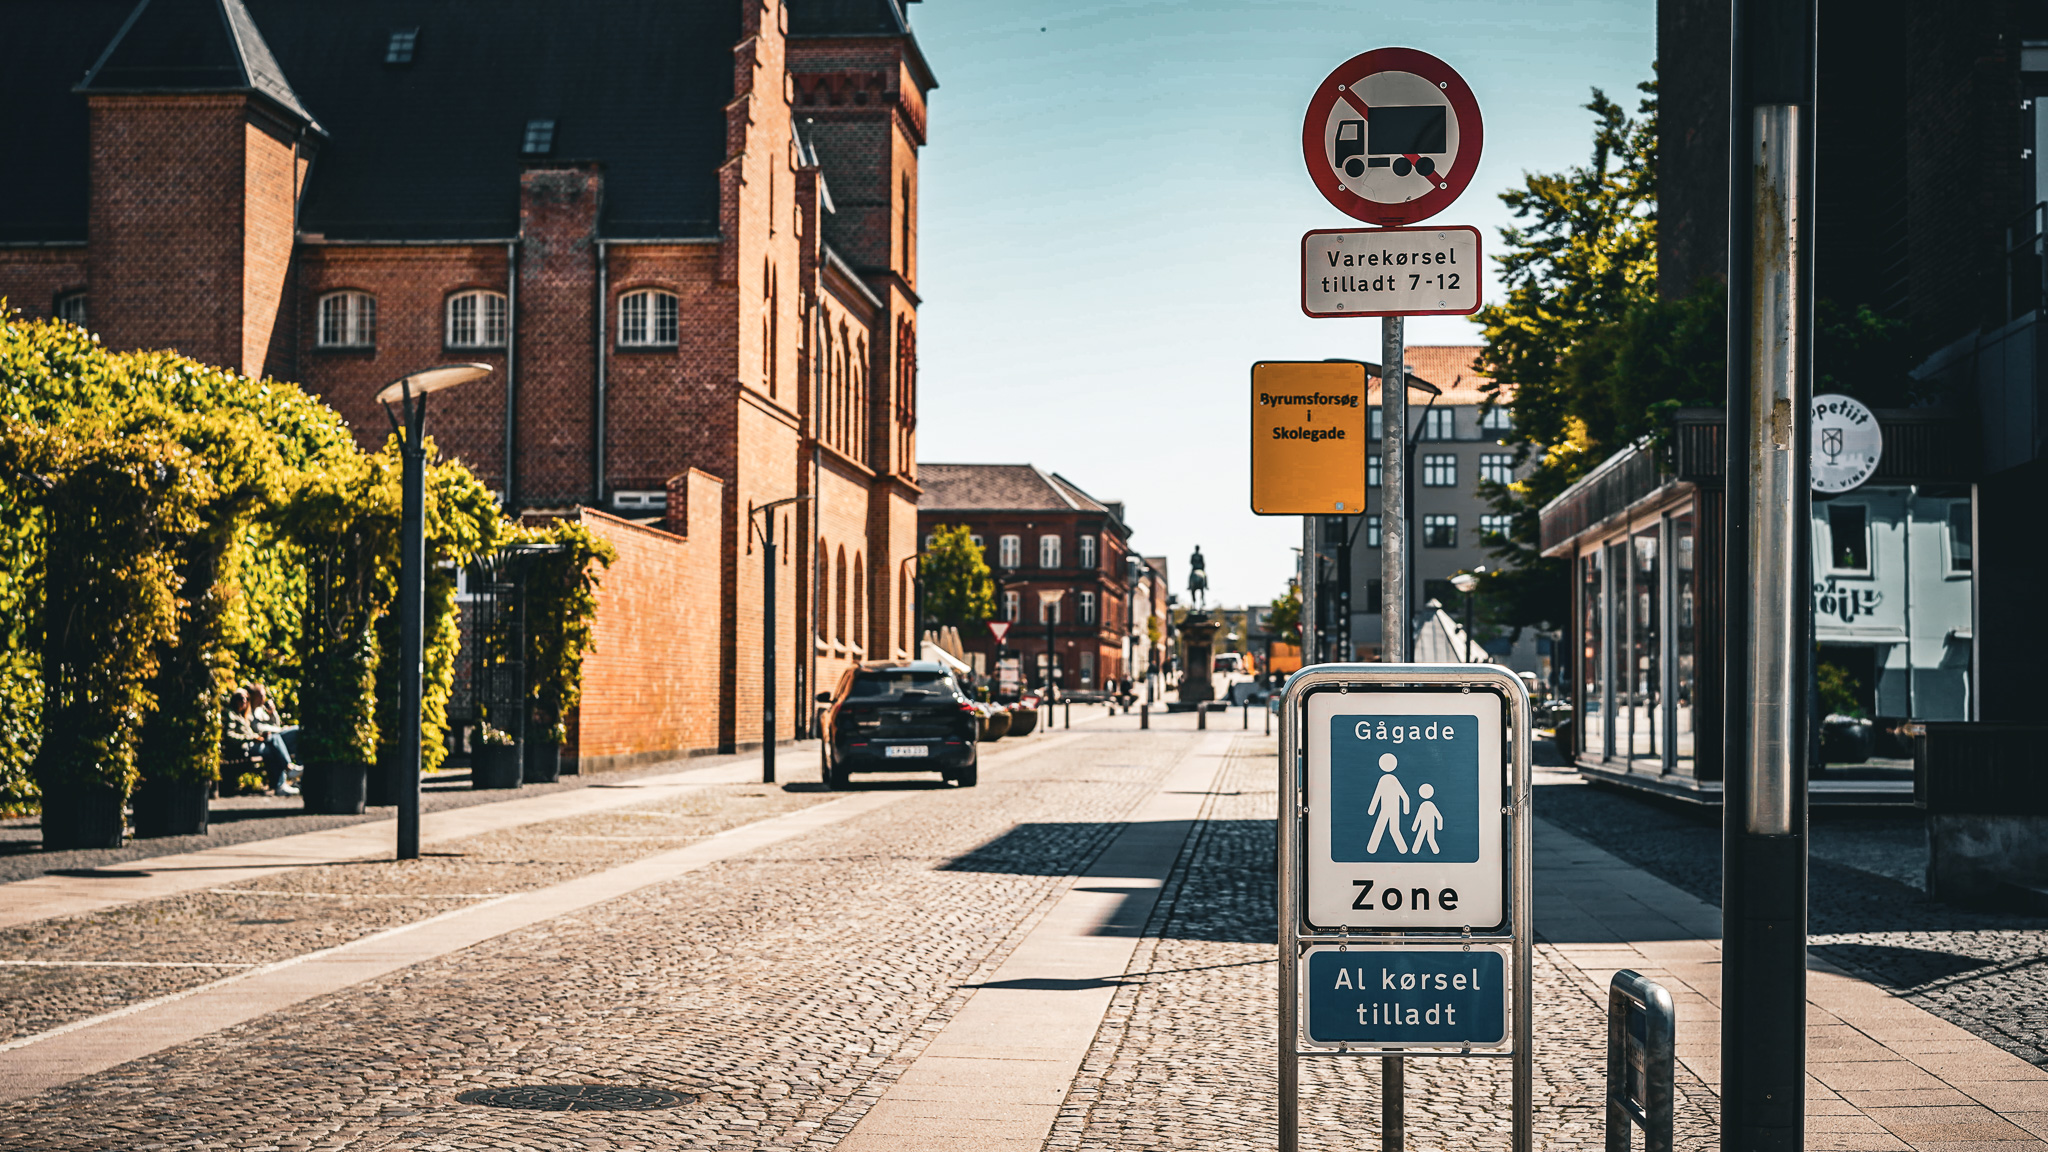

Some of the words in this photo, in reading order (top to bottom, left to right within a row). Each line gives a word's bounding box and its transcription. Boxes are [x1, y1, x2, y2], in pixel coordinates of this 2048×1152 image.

[1327, 248, 1457, 267] Varekørsel
[1321, 275, 1396, 293] tilladt
[1260, 392, 1358, 408] Byrumsforsøg
[1307, 410, 1311, 422] i
[1812, 400, 1869, 425] petiit
[1272, 427, 1346, 442] Skolegade
[1354, 720, 1455, 744] Gågade
[1352, 880, 1459, 911] Zone
[1334, 967, 1366, 990] Al
[1382, 967, 1481, 991] kørsel
[1356, 1002, 1456, 1025] tilladt
